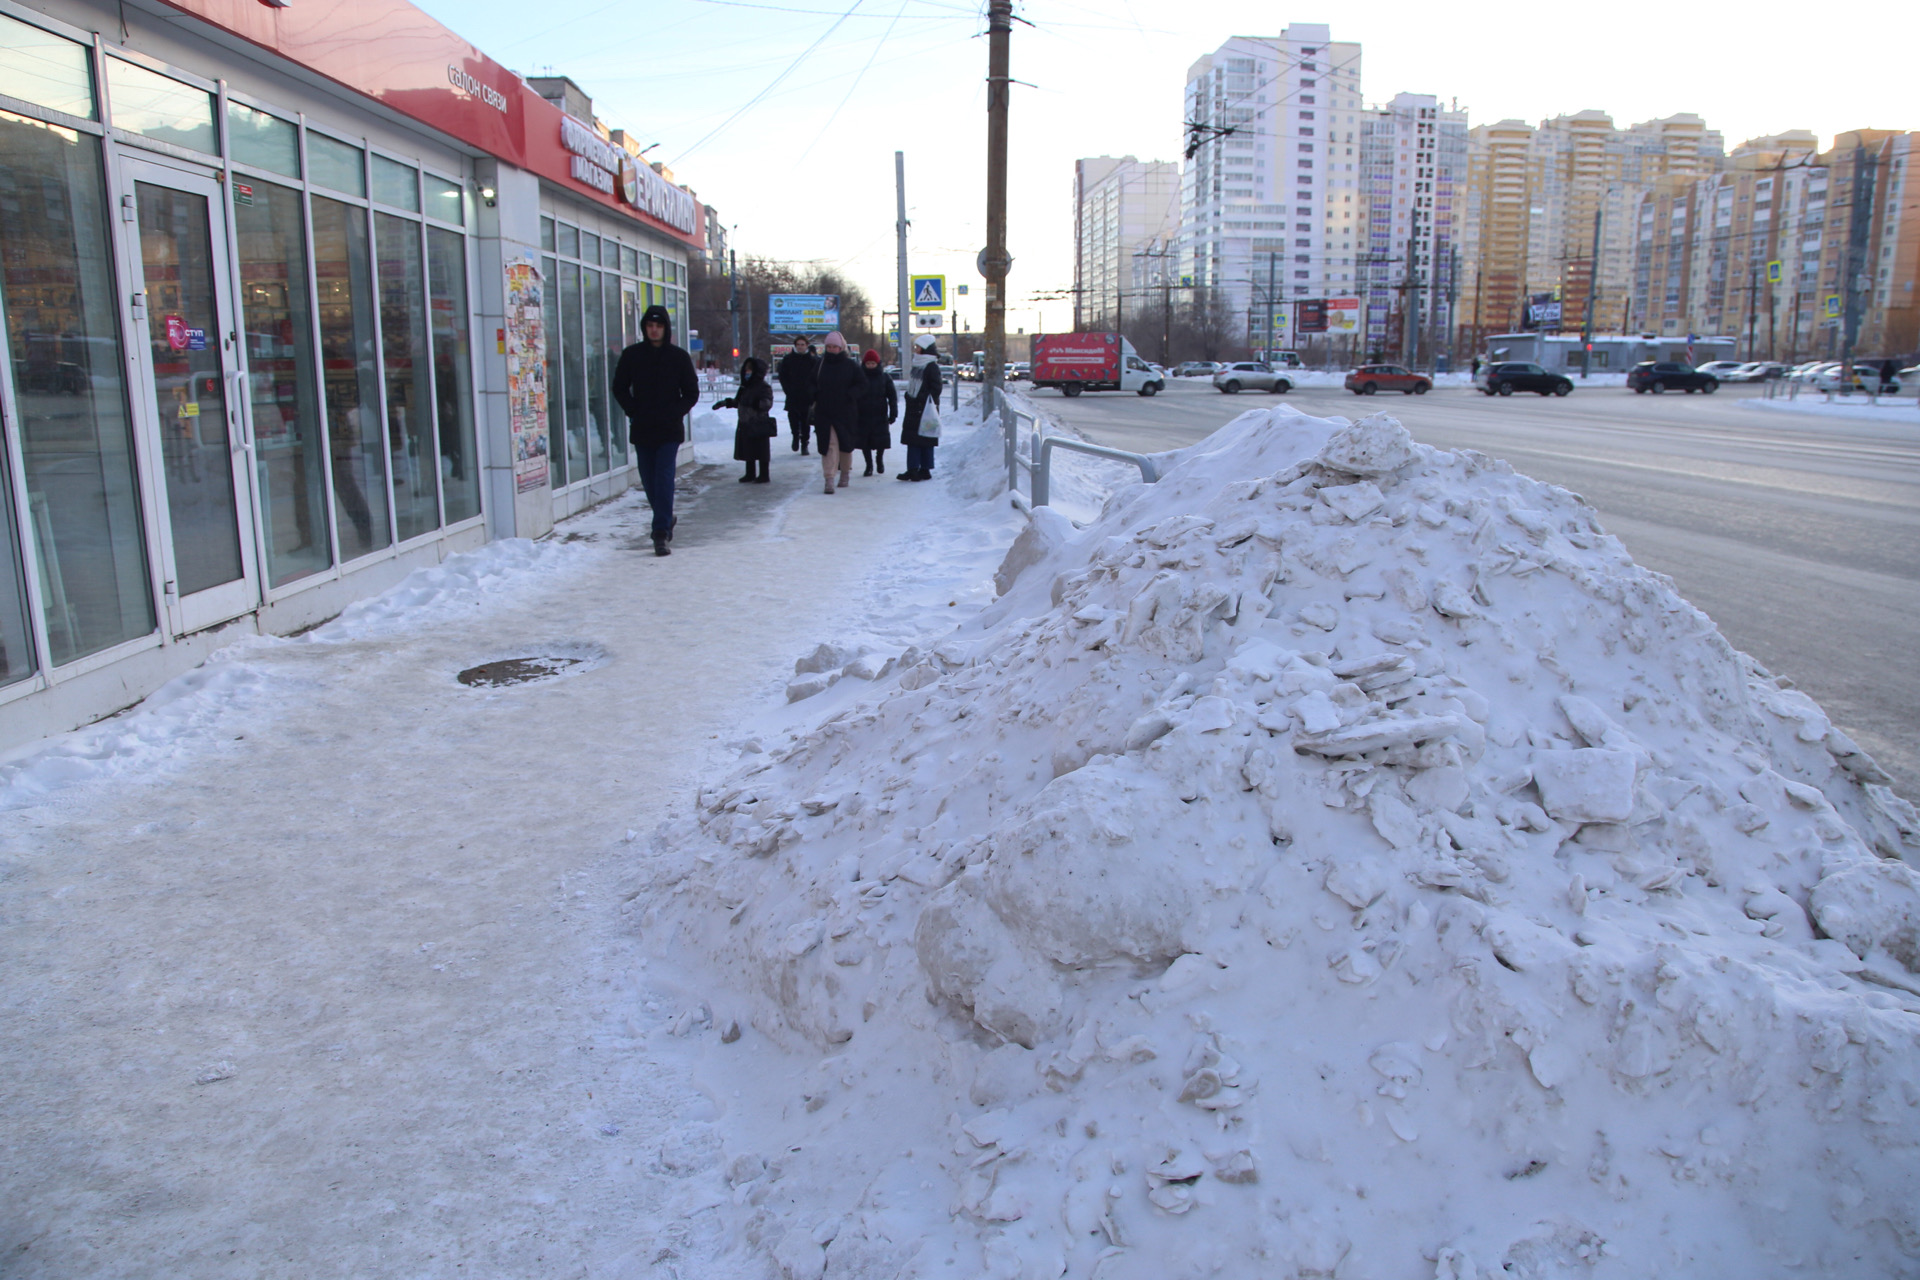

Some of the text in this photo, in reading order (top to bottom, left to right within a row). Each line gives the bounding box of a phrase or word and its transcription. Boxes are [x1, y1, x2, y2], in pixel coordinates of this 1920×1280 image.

[448, 64, 507, 114] салон связи
[571, 156, 614, 194] МАГАЗИН
[634, 160, 696, 235] ЕРМОЛИНО
